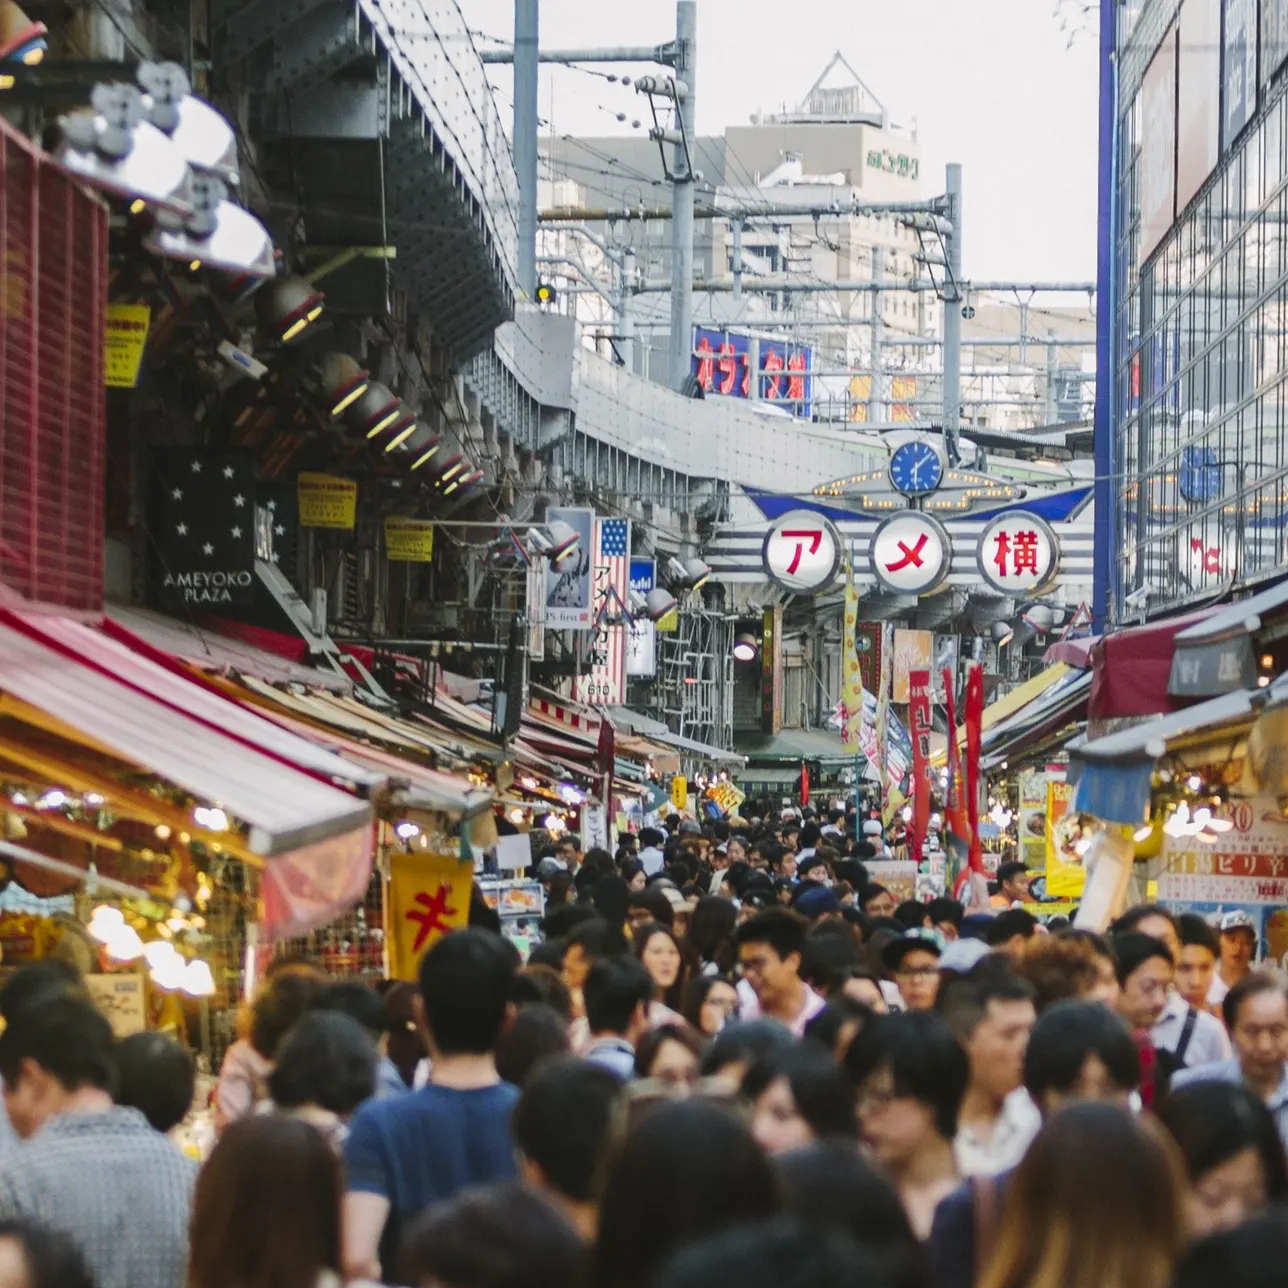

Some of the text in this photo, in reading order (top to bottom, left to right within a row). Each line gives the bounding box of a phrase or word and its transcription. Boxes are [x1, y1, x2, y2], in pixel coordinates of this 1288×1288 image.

[780, 529, 1038, 577] アメ横
[164, 570, 252, 588] AMEYOKO
[629, 576, 651, 590] sahi
[184, 587, 233, 603] PLAZA
